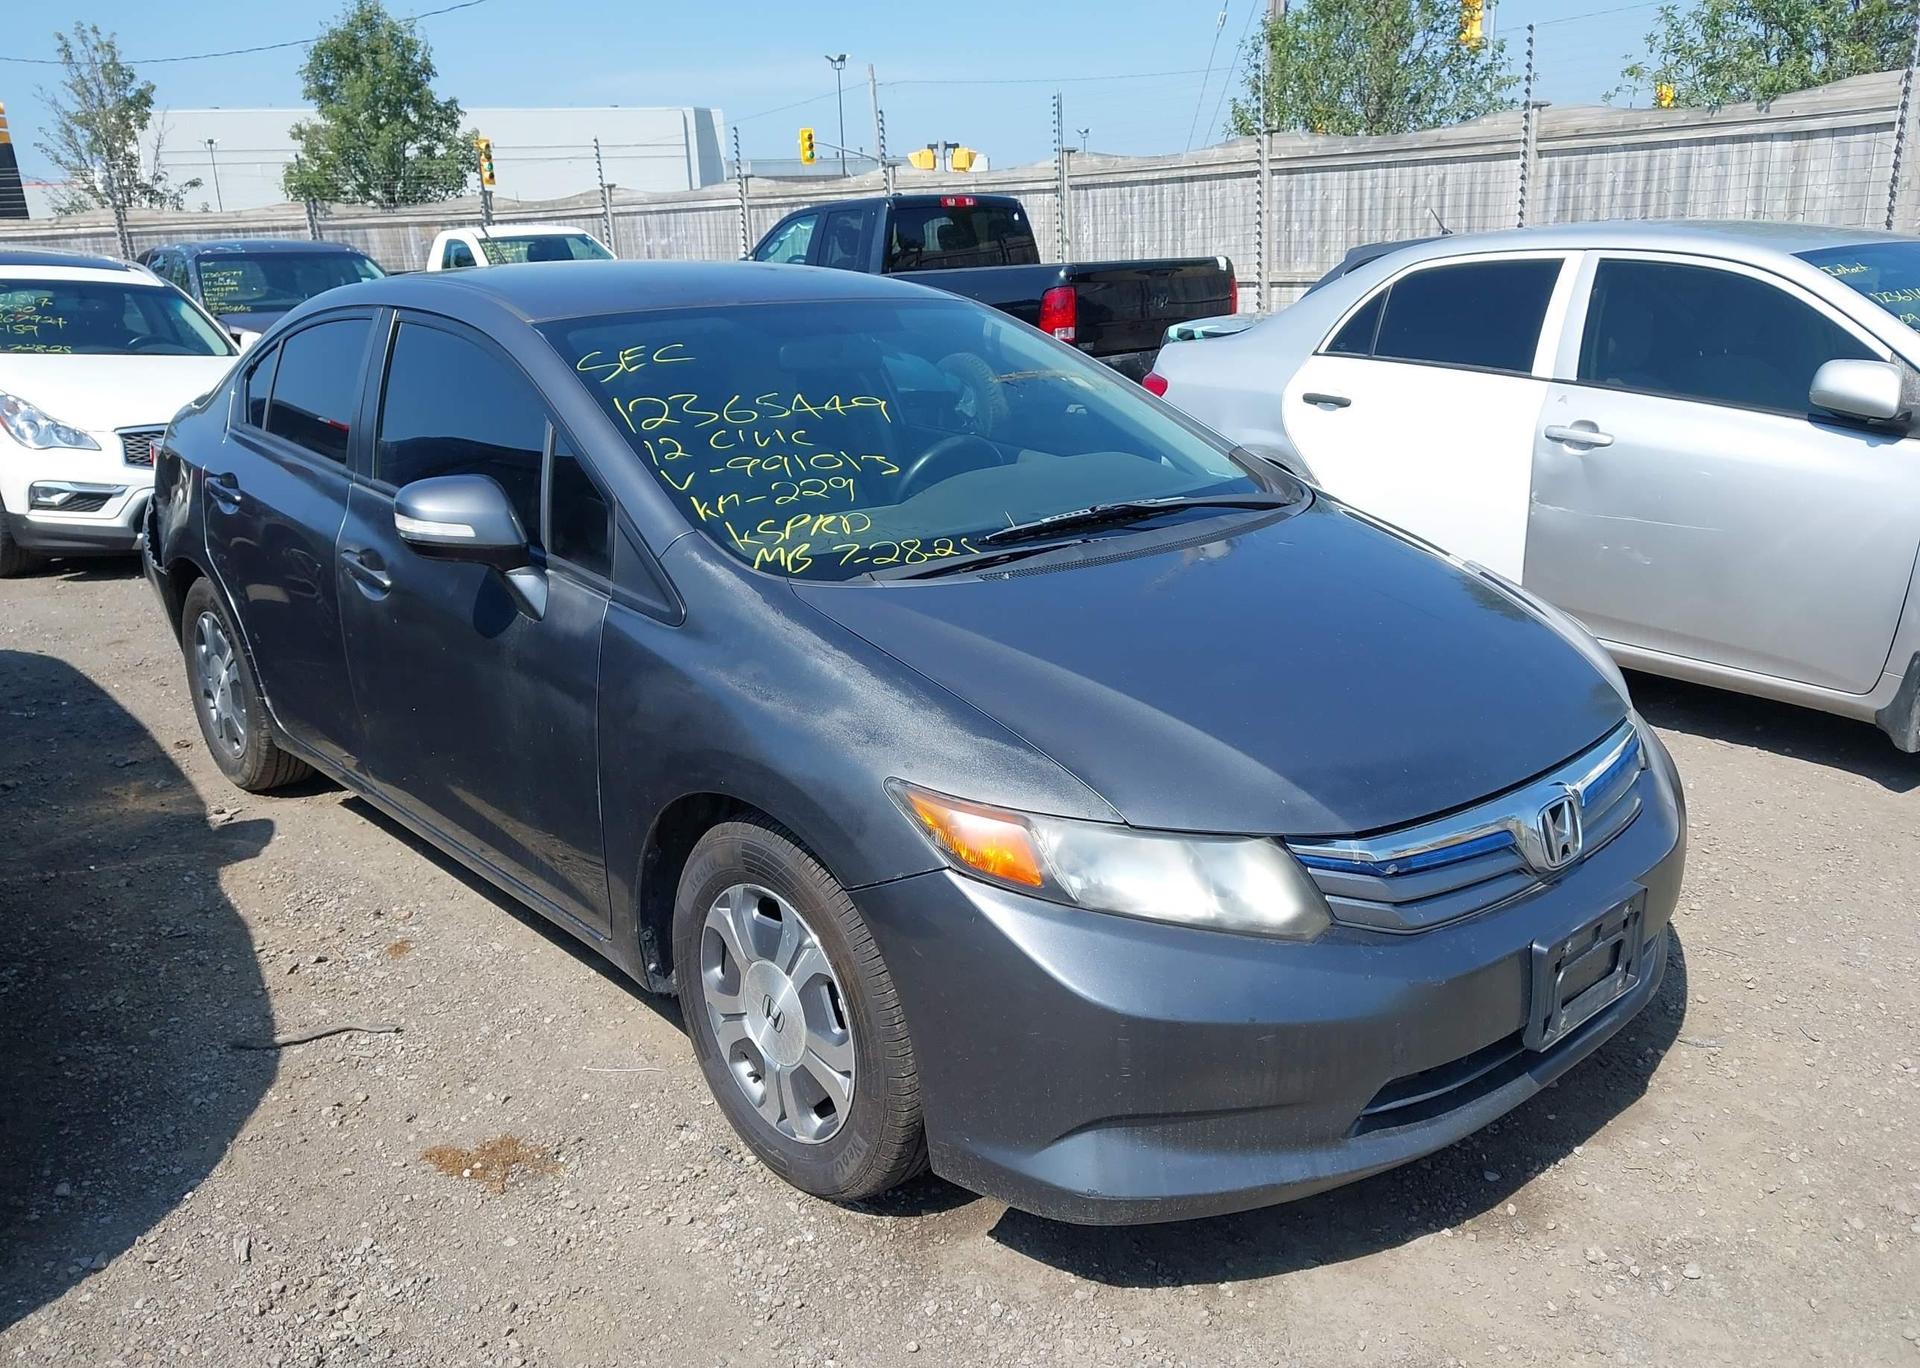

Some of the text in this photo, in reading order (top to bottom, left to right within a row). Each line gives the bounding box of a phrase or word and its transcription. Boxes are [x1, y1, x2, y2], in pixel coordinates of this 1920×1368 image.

[577, 344, 696, 382] SEC
[643, 438, 692, 466] 12
[754, 543, 813, 574] MB
